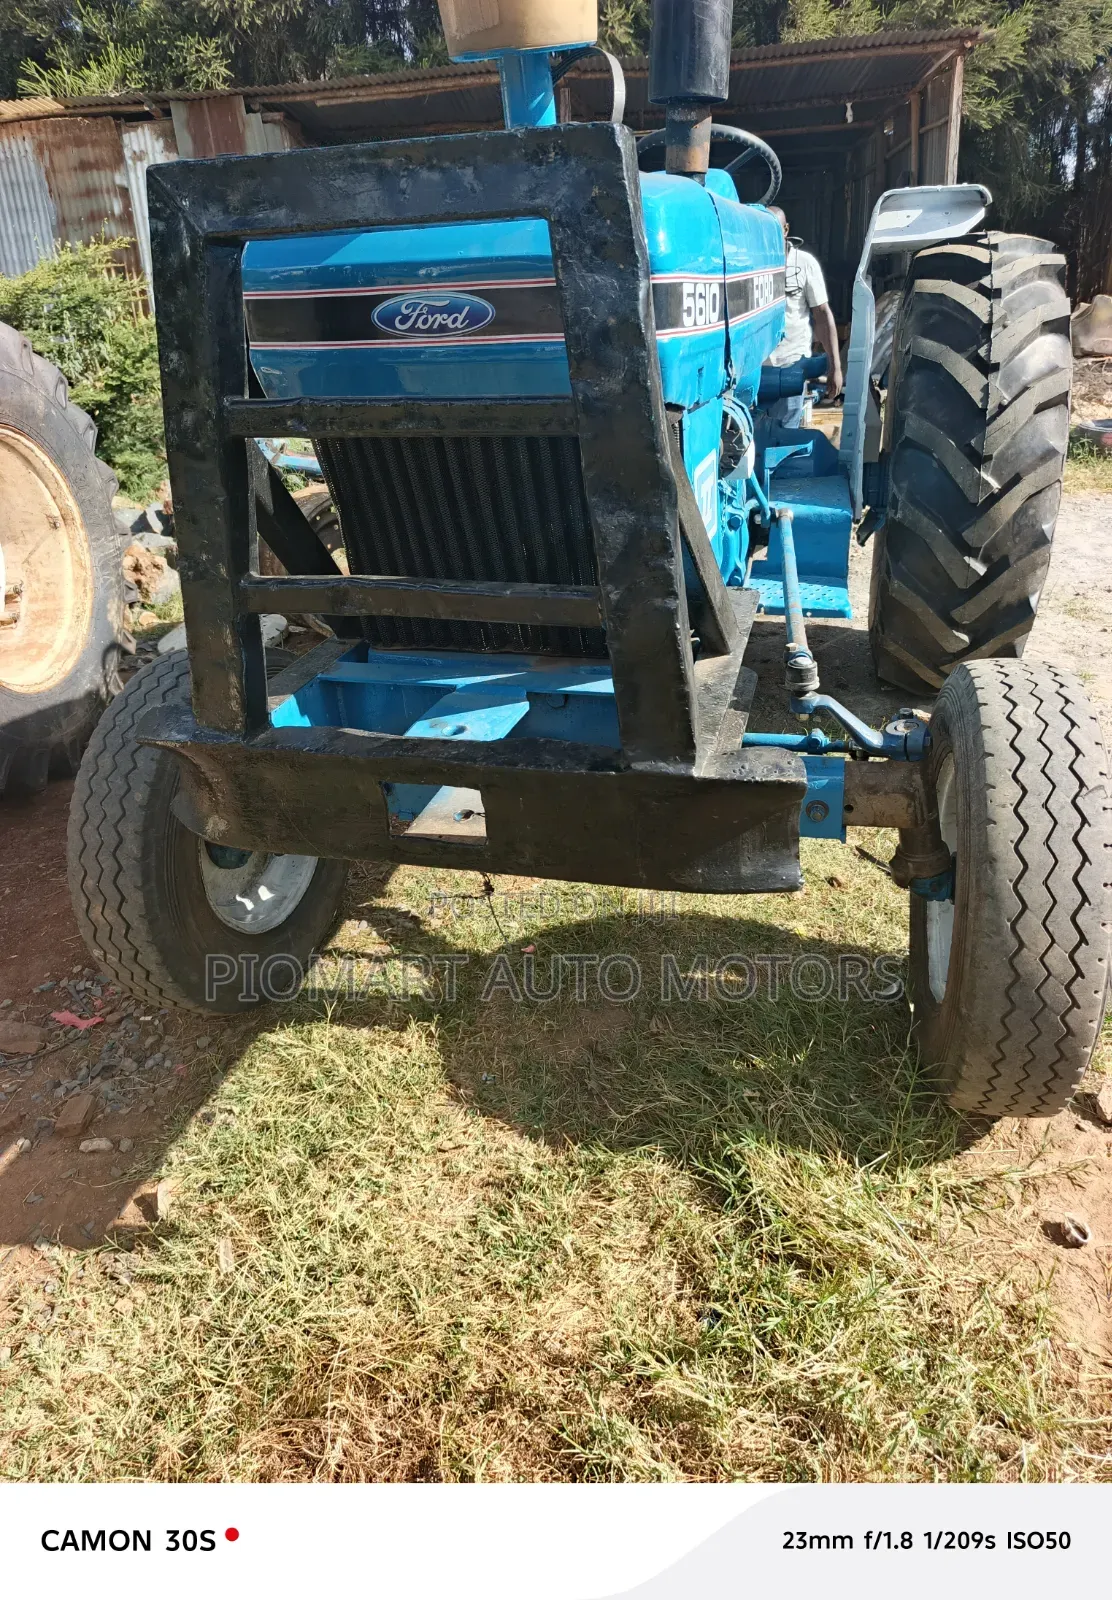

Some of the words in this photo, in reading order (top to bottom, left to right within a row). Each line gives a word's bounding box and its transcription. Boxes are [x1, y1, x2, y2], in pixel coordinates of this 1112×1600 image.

[682, 282, 720, 327] 5610
[753, 273, 774, 309] FORD
[394, 299, 471, 330] Ford
